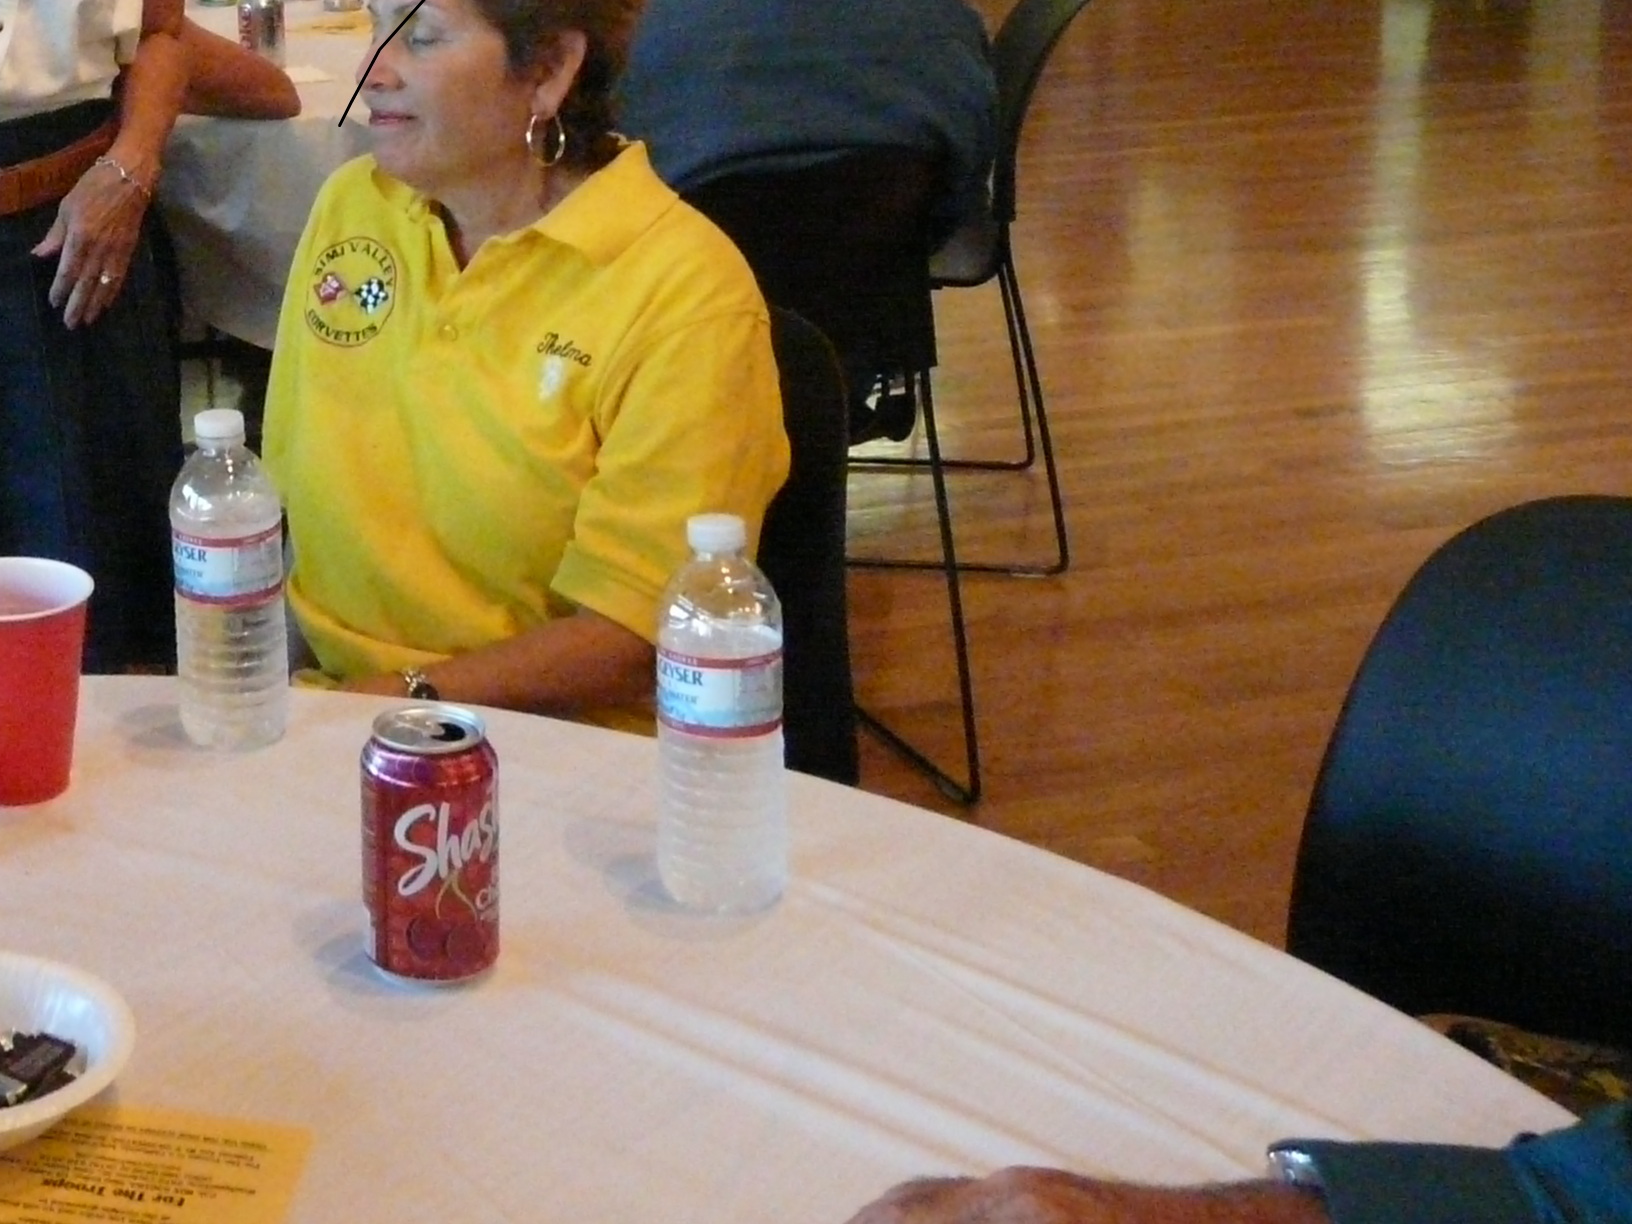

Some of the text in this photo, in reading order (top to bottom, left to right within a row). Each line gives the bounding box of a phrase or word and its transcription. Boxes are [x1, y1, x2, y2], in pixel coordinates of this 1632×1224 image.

[314, 241, 394, 287] SIMI VALLEY
[308, 308, 378, 342] CORVETTES
[536, 331, 593, 367] Thelma
[393, 800, 499, 897] Shas
